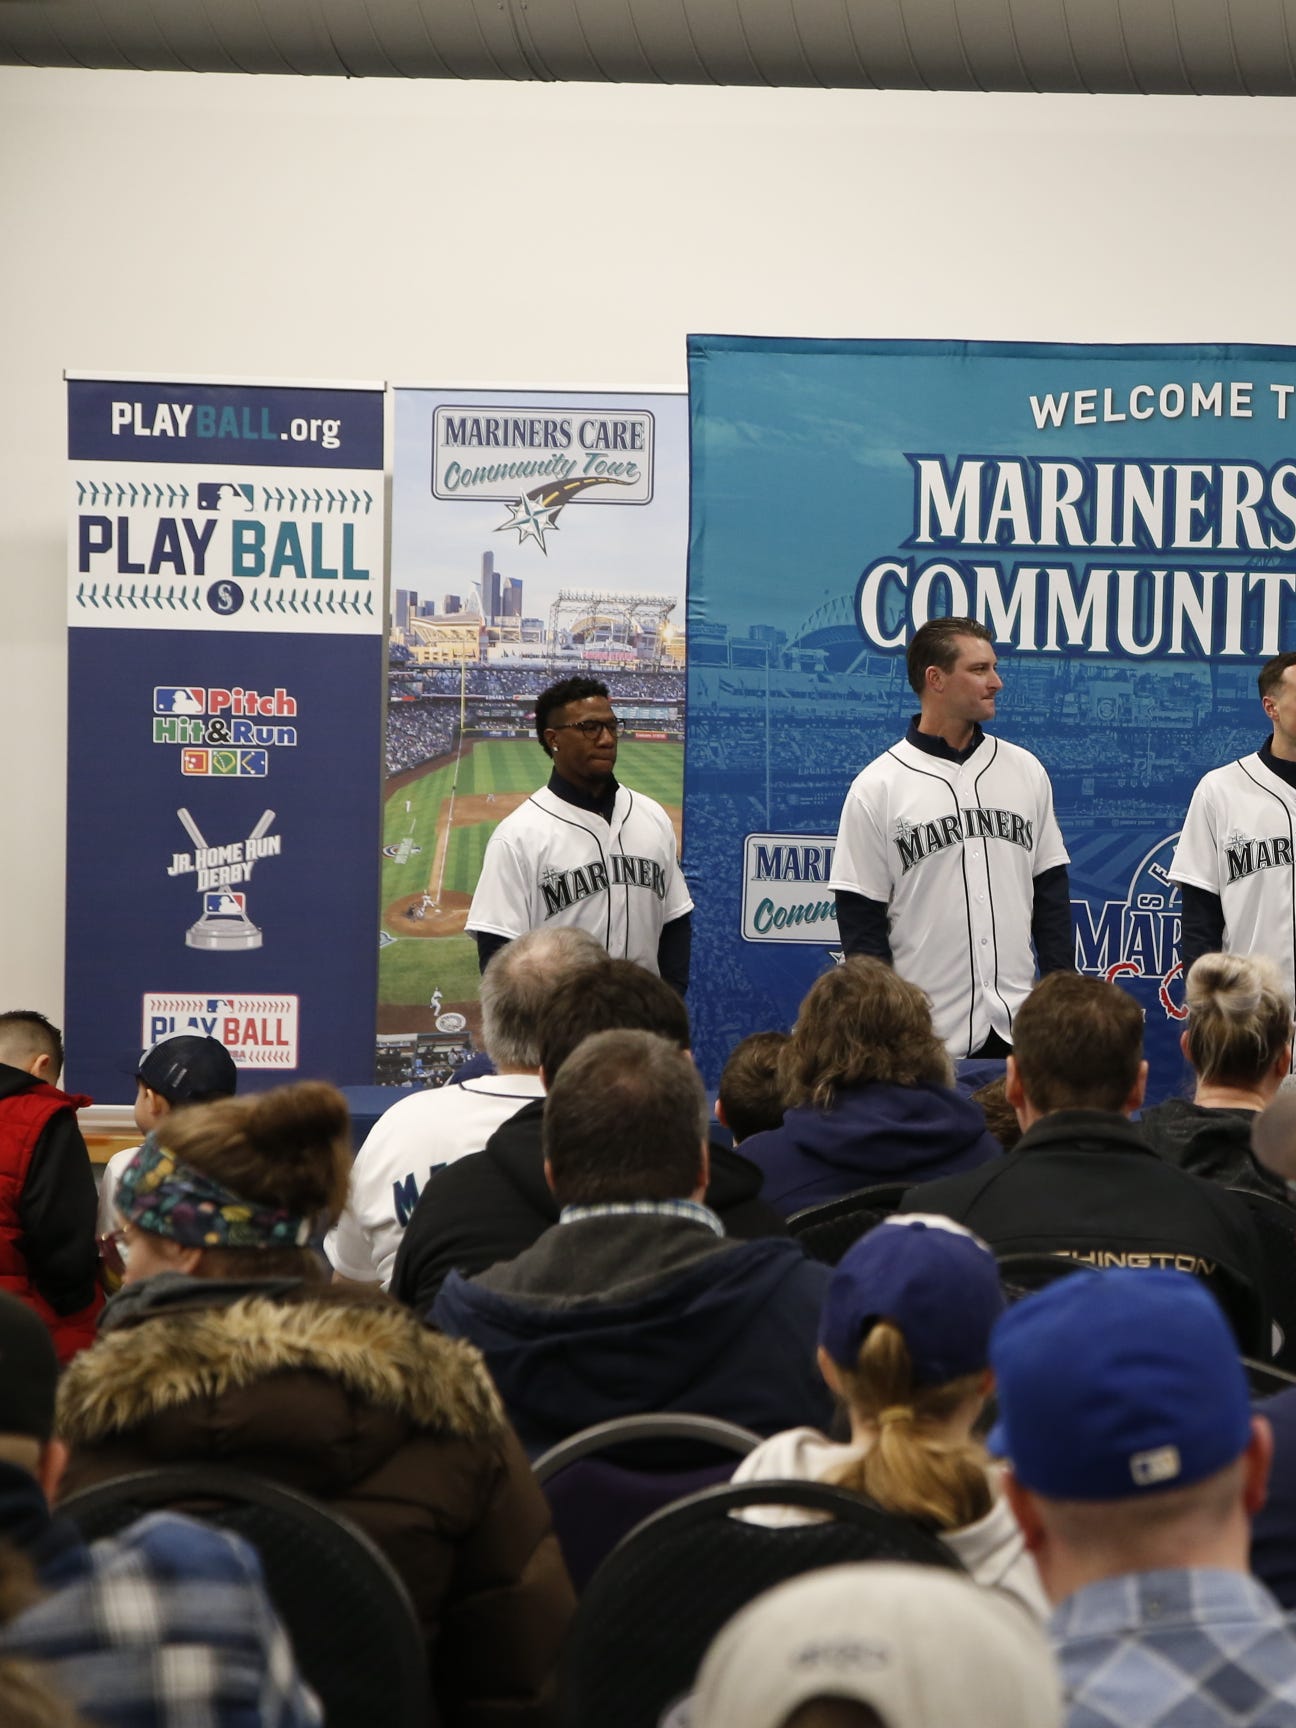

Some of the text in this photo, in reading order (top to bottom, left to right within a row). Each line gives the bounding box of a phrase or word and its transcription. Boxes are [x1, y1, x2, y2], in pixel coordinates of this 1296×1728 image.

[112, 402, 341, 449] PLAYBALL.org
[1030, 382, 1253, 430] WELCOME
[441, 416, 646, 451] MARINERS CARE
[444, 452, 638, 491] Community Tour
[78, 515, 370, 580] PLAY BALL
[208, 687, 297, 717] Pitch
[195, 842, 243, 870] HOME
[245, 835, 281, 861] RUN
[893, 808, 1033, 876] MARINERS
[197, 861, 255, 892] DERBY
[540, 854, 666, 920] MARINERS
[223, 1017, 290, 1046] BALL
